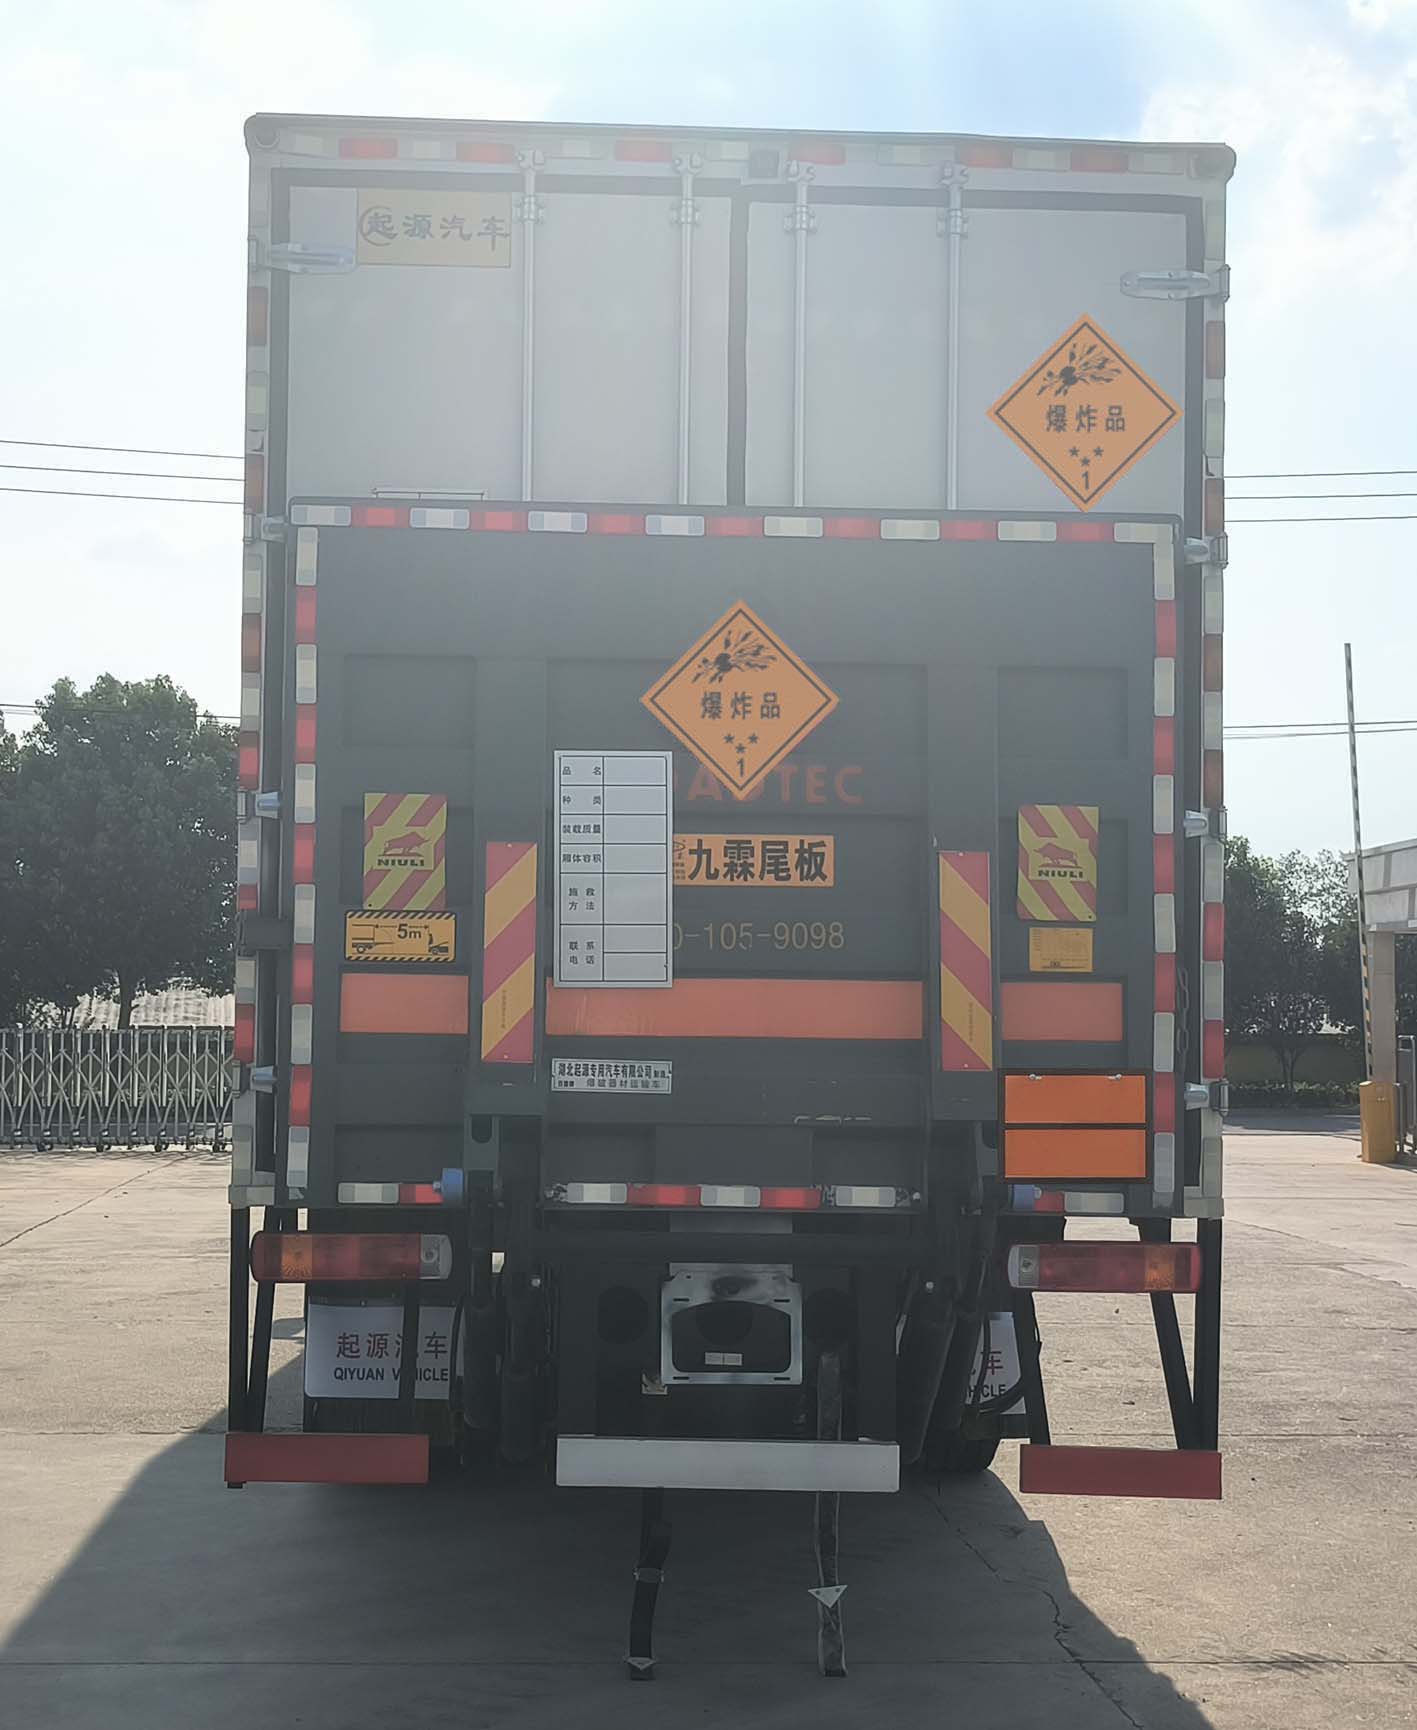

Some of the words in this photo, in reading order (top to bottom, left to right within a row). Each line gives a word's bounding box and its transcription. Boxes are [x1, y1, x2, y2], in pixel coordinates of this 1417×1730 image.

[364, 211, 511, 252] 起源汽车
[1045, 404, 1127, 434] 爆炸品
[1081, 471, 1091, 491] 1
[700, 691, 782, 720] 爆炸品
[736, 757, 745, 778] 1
[376, 858, 425, 867] NIULI
[687, 838, 828, 882] 九霖尾板
[1037, 869, 1084, 879] NIULI
[396, 923, 422, 940] 5m
[558, 1062, 652, 1079] 湖北起源专用汽车有限公司
[333, 1367, 385, 1381] QIYUAN
[391, 1367, 450, 1381] VICLE
